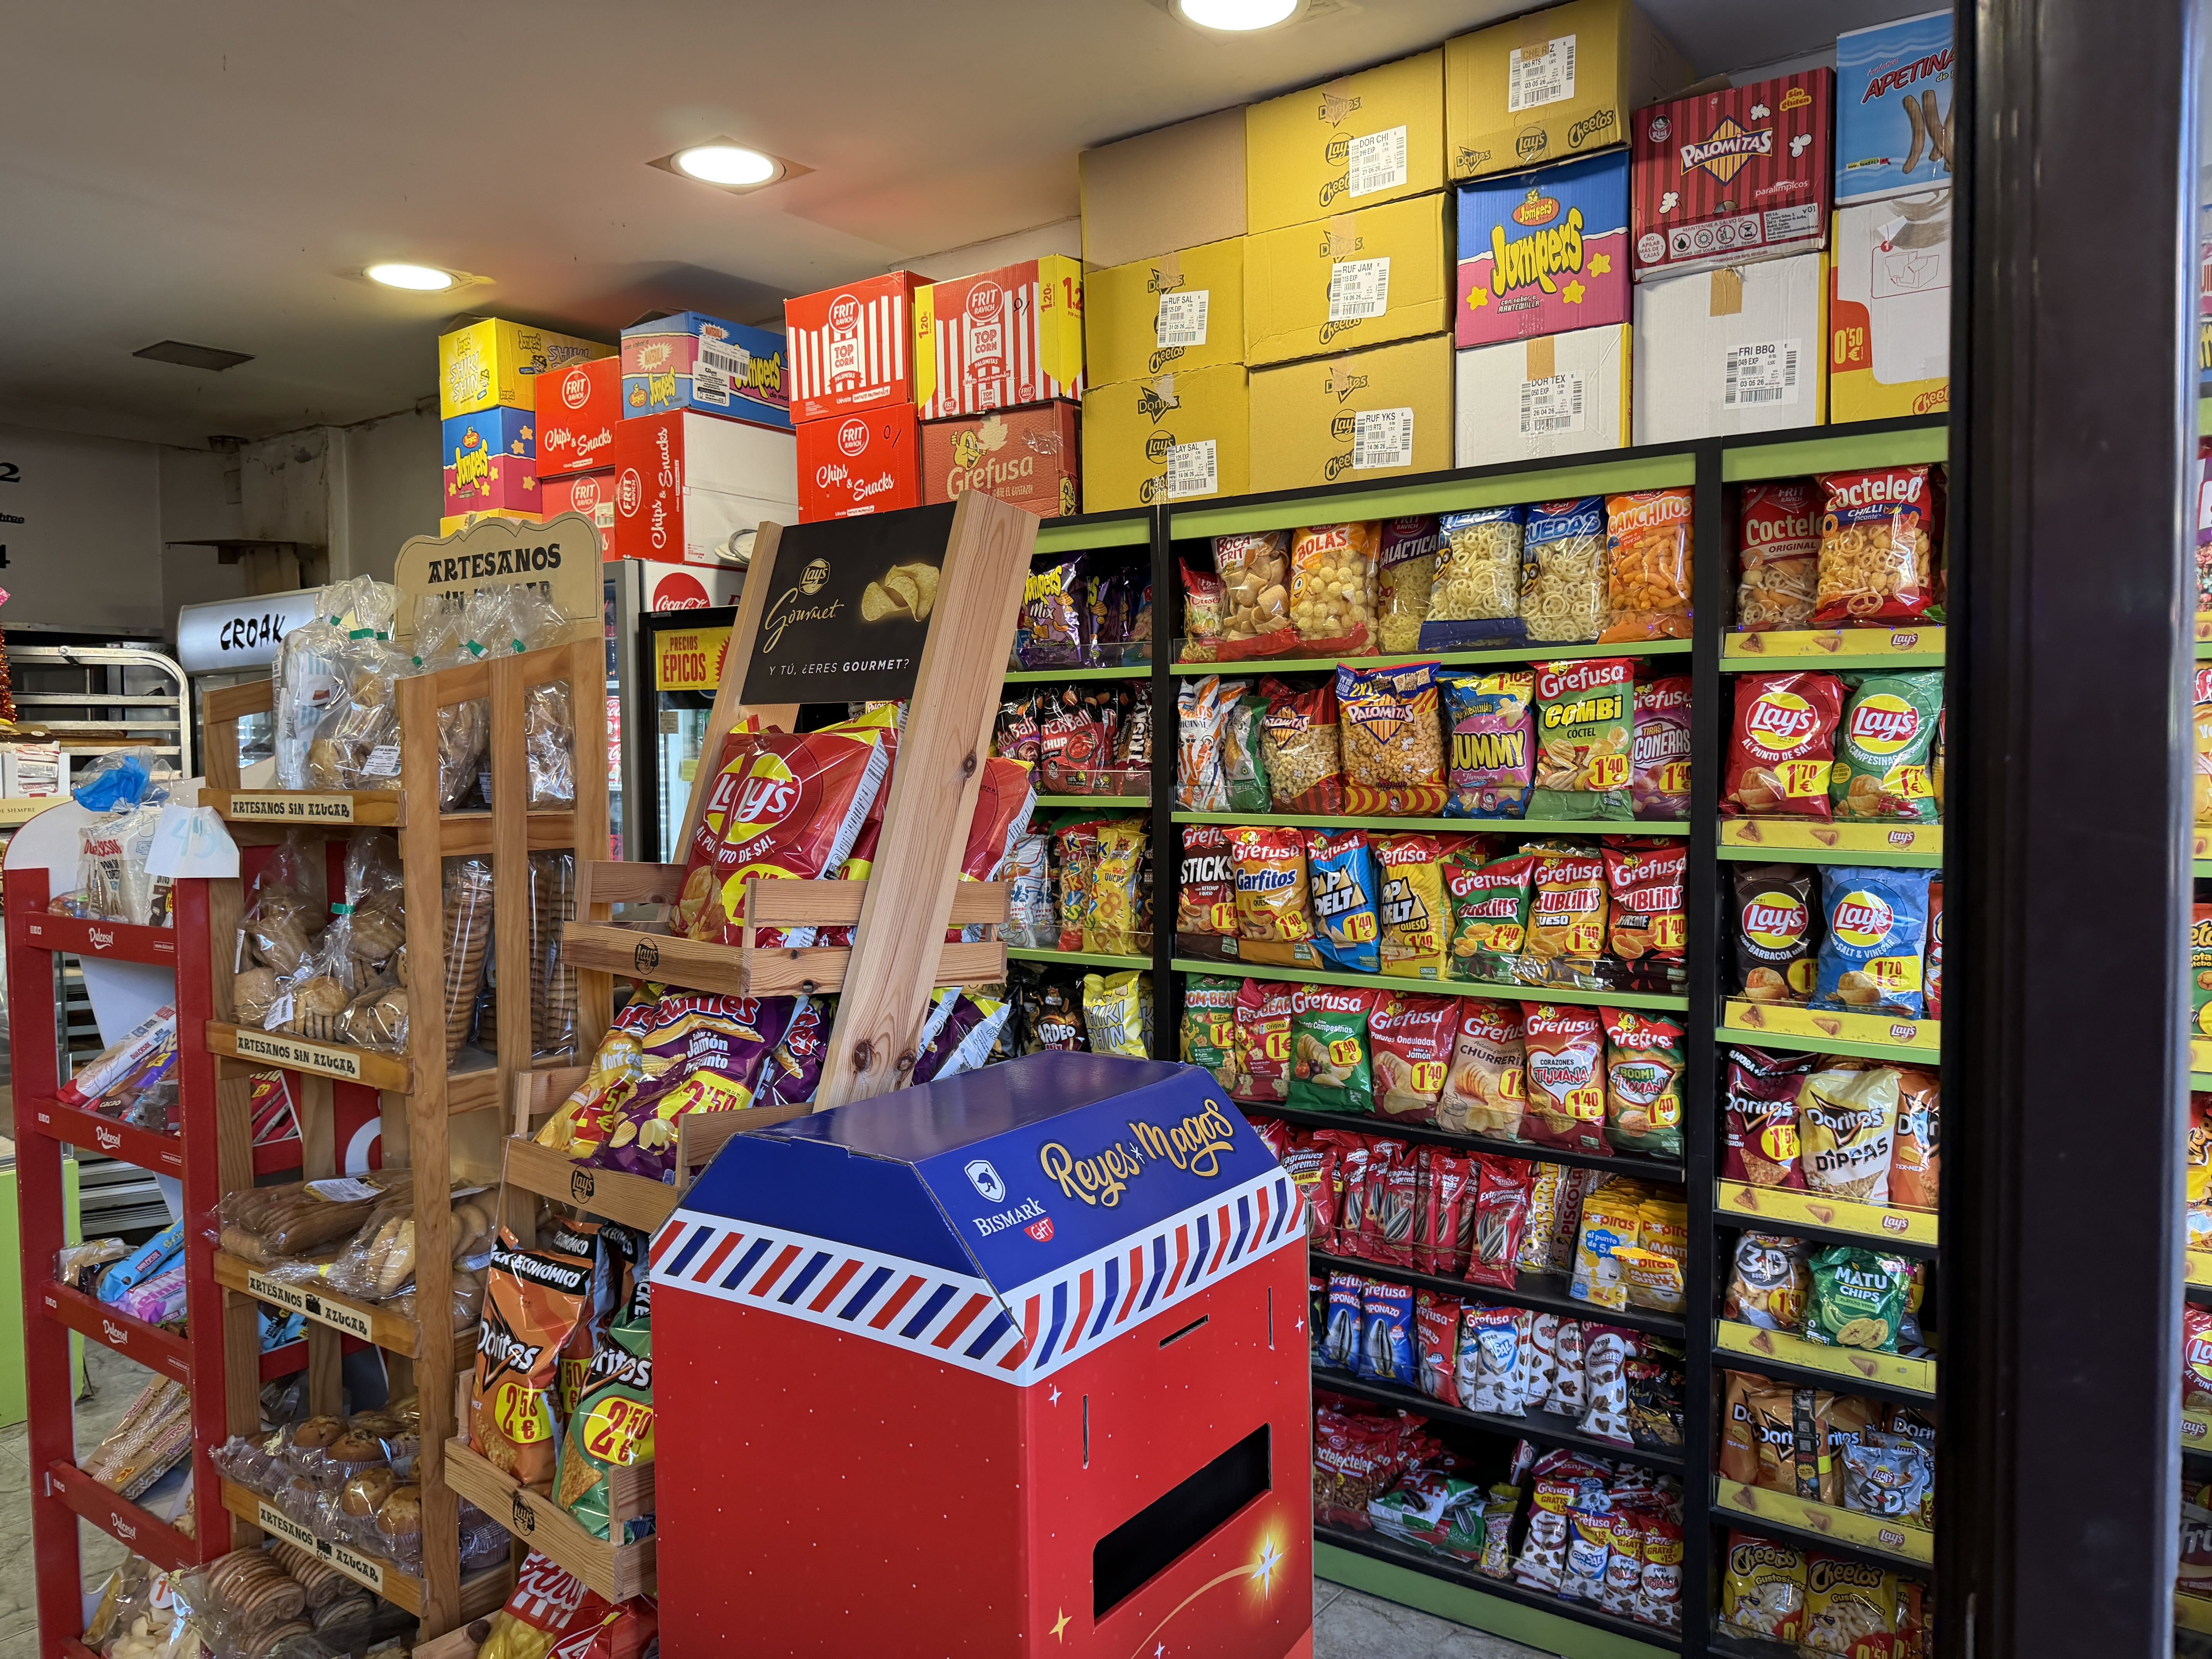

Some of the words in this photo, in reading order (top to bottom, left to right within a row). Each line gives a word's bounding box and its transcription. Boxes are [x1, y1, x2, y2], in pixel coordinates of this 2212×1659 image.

[1781, 96, 1809, 109] gluten
[1788, 89, 1803, 98] Sin
[1568, 110, 1614, 149] Cheetos
[1360, 137, 1374, 148] DOR
[1377, 133, 1388, 143] CHI
[1520, 201, 1553, 222] Jumpers
[1490, 207, 1583, 298] Jumpers
[1343, 265, 1356, 273] RUF
[1358, 263, 1372, 271] JAM
[972, 290, 998, 307] FRIT
[1498, 300, 1540, 313] MANTEQUILLA
[833, 303, 855, 318] FRIT
[974, 303, 995, 315] RAVICH
[975, 329, 996, 344] TOP
[835, 345, 854, 359] TOP
[975, 342, 997, 354] CORN
[1739, 347, 1752, 356] FRI
[1756, 345, 1775, 354] BBQ
[450, 351, 479, 384] SHIKI
[835, 355, 854, 367] CORN
[974, 359, 998, 368] PALOMITAS
[566, 378, 585, 393] FRIT
[649, 365, 675, 407] Jumpers
[835, 373, 855, 381] PALOMITAS
[1532, 378, 1548, 386] DOR
[1551, 374, 1565, 384] TEX
[453, 372, 479, 402] SHIN
[1366, 414, 1380, 422] RUF
[1382, 412, 1395, 421] YKS
[544, 427, 571, 452] Chips
[577, 428, 612, 456] Snacks
[842, 428, 864, 442] FRIT
[845, 440, 862, 448] RAVICH
[1175, 445, 1187, 453] LAY
[455, 438, 488, 489] Jumpers
[652, 499, 667, 548] Chips
[660, 427, 672, 488] Snacks
[816, 464, 849, 488] Chips
[853, 472, 894, 501] Snacks
[946, 456, 1033, 500] Grefusa
[575, 483, 595, 499] FRIT
[1006, 487, 1010, 496] EL
[1609, 496, 1692, 535] GANCHITOS
[1848, 504, 1883, 518] CHILLI
[1396, 522, 1419, 530] RAVICH
[1216, 536, 1250, 556] BOCA
[1298, 531, 1348, 561] BOLAS
[1769, 543, 1815, 553] ORIGINAL
[428, 544, 561, 583] ARTESANOS
[802, 567, 828, 587] Lay's
[764, 587, 844, 654] Gourmet
[1030, 604, 1055, 620] Mix
[670, 636, 698, 651] PRECIOS
[1893, 634, 1917, 646] Lay's
[663, 649, 706, 682] ÉPICOS
[770, 666, 776, 675] Y
[781, 663, 797, 676] TÚ,
[802, 661, 837, 675] ¿ERES
[843, 659, 909, 672] GOURMET?
[1540, 665, 1624, 697] Grefusa
[1751, 702, 1813, 736] Lay's
[1853, 707, 1915, 741] Lay's
[1567, 728, 1596, 738] CÓCTEL
[1642, 724, 1662, 735] TIRAS
[1452, 732, 1525, 771] JUMMY
[1741, 738, 1751, 749] AL
[1751, 747, 1779, 761] PUNTO
[1782, 751, 1793, 760] DE
[1794, 744, 1812, 757] SAL
[233, 802, 284, 815] ARTESANOS
[308, 803, 349, 817] AZUCAR
[1890, 831, 1914, 843] Lay's
[1236, 868, 1297, 891] Garfitos
[1534, 864, 1603, 885] Grefusa
[1615, 857, 1687, 886] Grefusa
[1401, 919, 1427, 931] QUESO
[1747, 905, 1804, 936] Lay's
[1835, 903, 1889, 934] Lay's
[89, 928, 114, 945] Dulcesol
[1836, 943, 1853, 957] SALT
[1856, 950, 1862, 958] &
[1864, 939, 1895, 958] VINEGAR
[1292, 992, 1362, 1013] Grefusa
[1266, 1021, 1286, 1031] Original
[1313, 1022, 1353, 1034] Campesinas
[1370, 1009, 1443, 1030] Grefusa
[1527, 1015, 1595, 1035] Grefusa
[1371, 1032, 1395, 1042] Patatas
[1397, 1036, 1436, 1046] Onduladas
[1891, 1025, 1915, 1038] Lay's
[238, 1037, 290, 1058] ARTESANOS
[314, 1054, 354, 1073] AZUCAR
[687, 1035, 728, 1057] Jamón
[1406, 1049, 1431, 1060] Jamón
[1729, 1049, 1754, 1071] AHORA
[1534, 1066, 1589, 1085] TIJUANA
[1724, 1092, 1793, 1117] Doritos
[1806, 1108, 1884, 1130] Doritos
[97, 1126, 121, 1147] Dulcesol
[1040, 1141, 1140, 1207] Reyes
[1139, 1098, 1234, 1178] Magos
[1884, 1215, 1908, 1230] Lay's
[1595, 1235, 1617, 1244] punto
[514, 1254, 580, 1286] ECONÓMICO
[1630, 1269, 1673, 1280] MANTE
[1835, 1266, 1887, 1289] MATU
[1840, 1286, 1880, 1302] CHIPS
[250, 1278, 302, 1307] ARTESANOS
[325, 1308, 367, 1336] AZUCAR
[103, 1320, 128, 1341] Dulcesol
[477, 1321, 539, 1372] Doritos
[112, 1513, 136, 1535] Dulcesol
[260, 1509, 313, 1546] ARTESANOS
[336, 1550, 378, 1582] AZUCAR
[1880, 1530, 1905, 1544] Lay's
[1731, 1545, 1797, 1575] Cheetos
[1810, 1561, 1884, 1593] Cheetos
